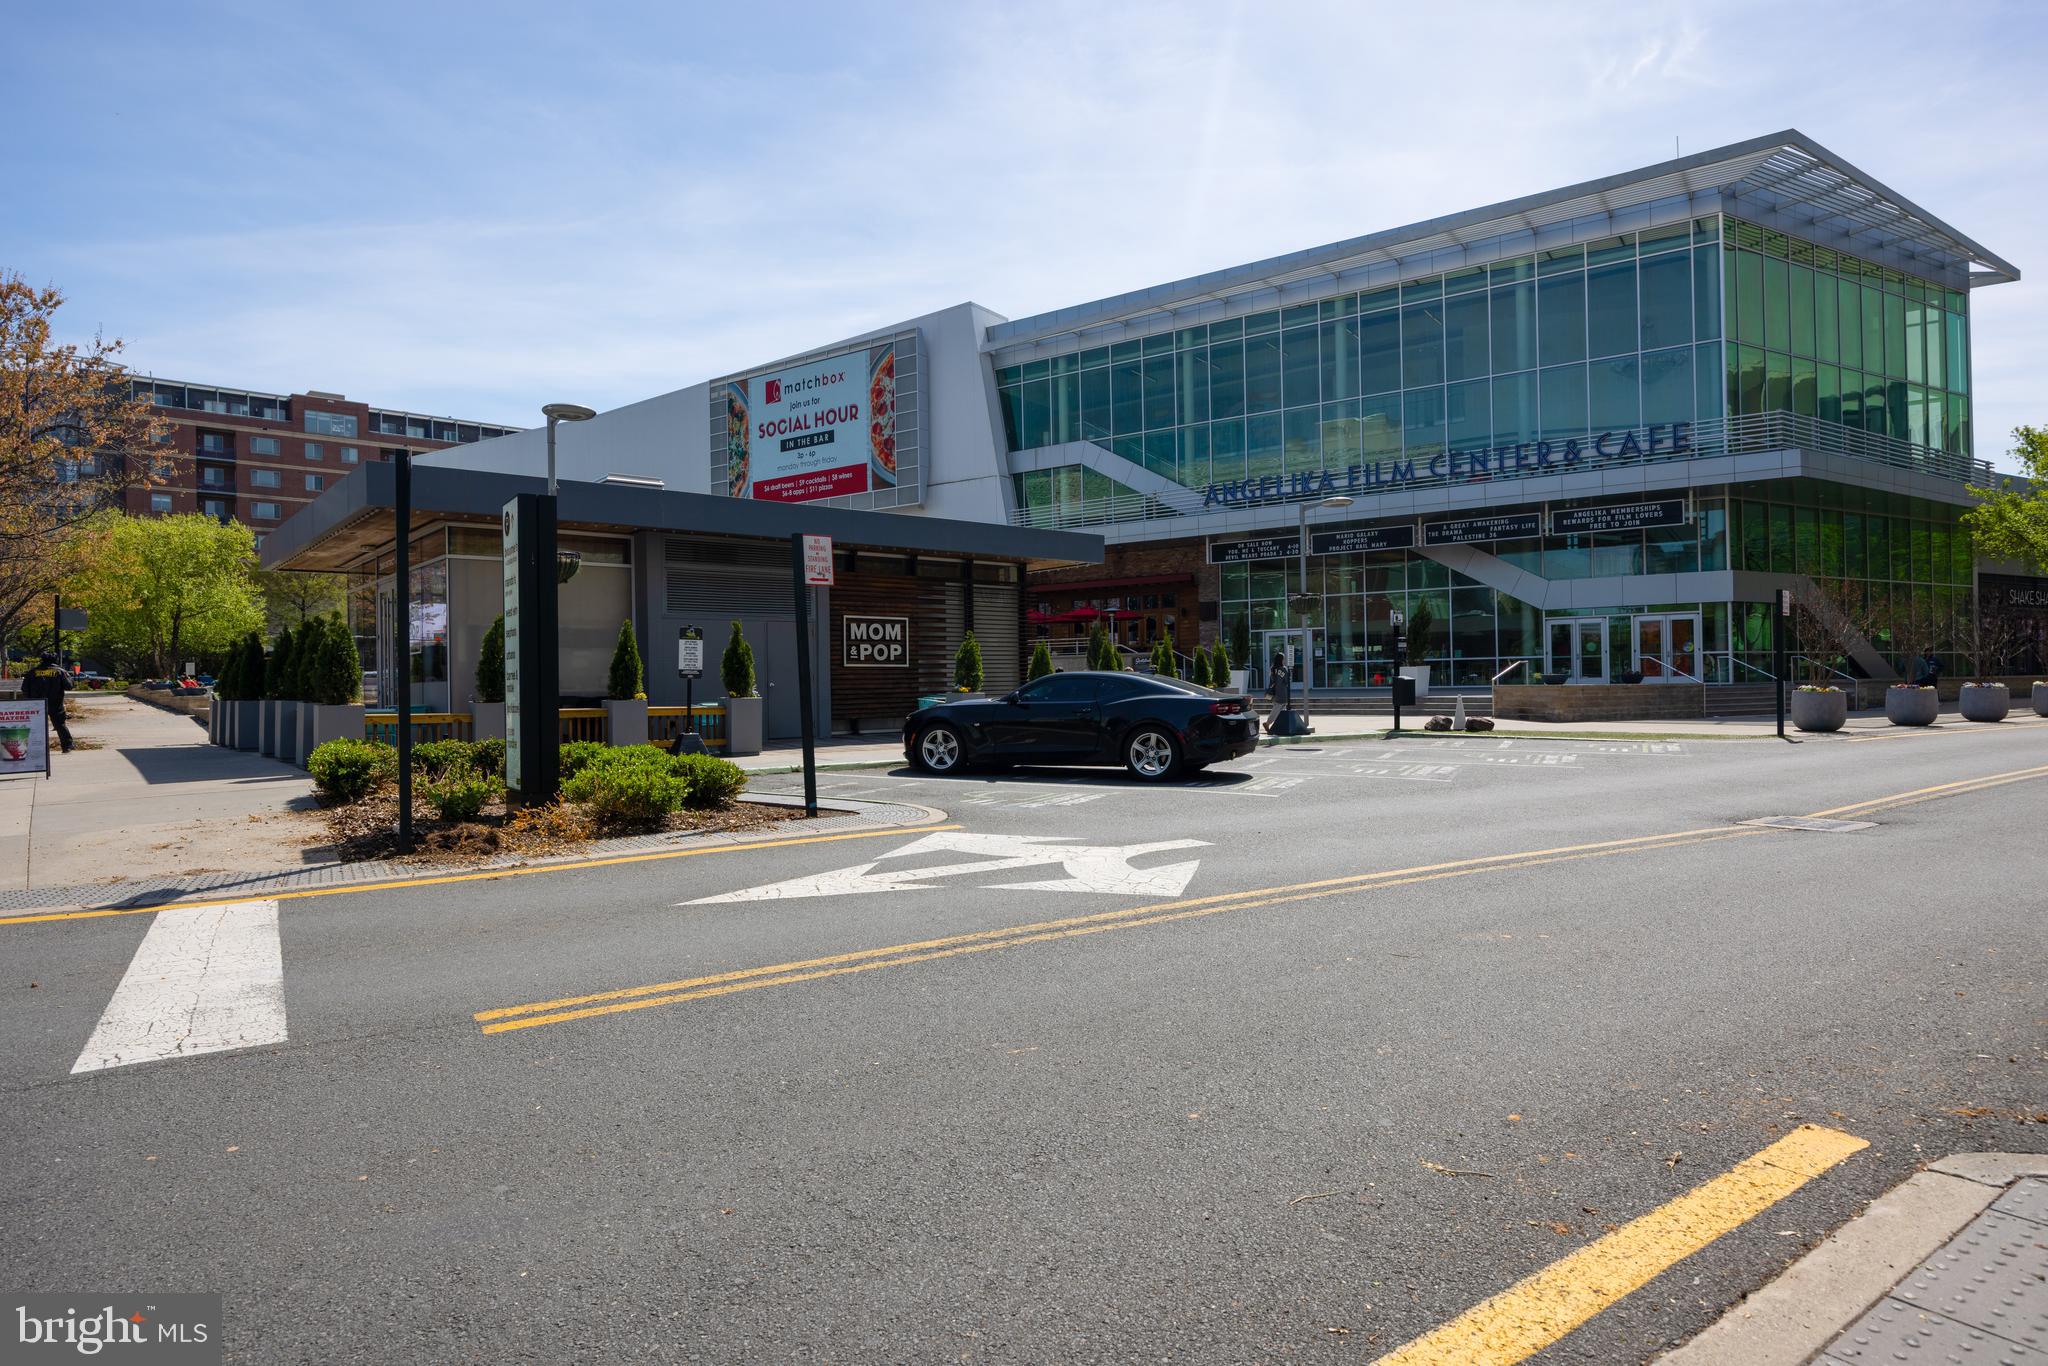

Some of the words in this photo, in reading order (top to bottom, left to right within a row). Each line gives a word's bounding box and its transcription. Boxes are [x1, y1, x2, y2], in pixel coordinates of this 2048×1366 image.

[784, 372, 845, 394] matchbox
[790, 401, 801, 411] join
[759, 414, 811, 439] SOCIAL
[815, 404, 859, 428] HOUR
[786, 441, 794, 449] IN
[797, 437, 810, 447] THE
[814, 434, 829, 444] BAR
[777, 463, 798, 471] monday
[800, 459, 820, 468] through
[822, 455, 838, 464] friday
[1204, 470, 1334, 506] ANGELIKA
[1347, 459, 1416, 488] FILM
[1429, 441, 1552, 477] CENTER
[1564, 438, 1585, 462] &
[806, 475, 827, 485] cocktails
[819, 484, 834, 492] pizzas
[1563, 517, 1596, 526] REWARDS
[1635, 511, 1664, 520] LOVERS
[1574, 510, 1607, 519] ANGELIKA
[1610, 505, 1662, 515] MEMBERSHIPS
[1441, 529, 1463, 537] DRAMA
[1489, 524, 1518, 532] FANTASY
[1450, 522, 1470, 530] GREAT
[1472, 518, 1510, 528] AWAKENING
[1589, 522, 1607, 530] FREE
[1623, 519, 1641, 527] JOIN
[1452, 533, 1487, 541] PALESTINE
[808, 544, 827, 552] PARKING
[806, 565, 817, 573] FIRE
[818, 566, 832, 574] LANE
[2010, 589, 2034, 605] SHAKE
[850, 623, 901, 640] MOM
[850, 645, 859, 658] &
[860, 644, 902, 661] POP
